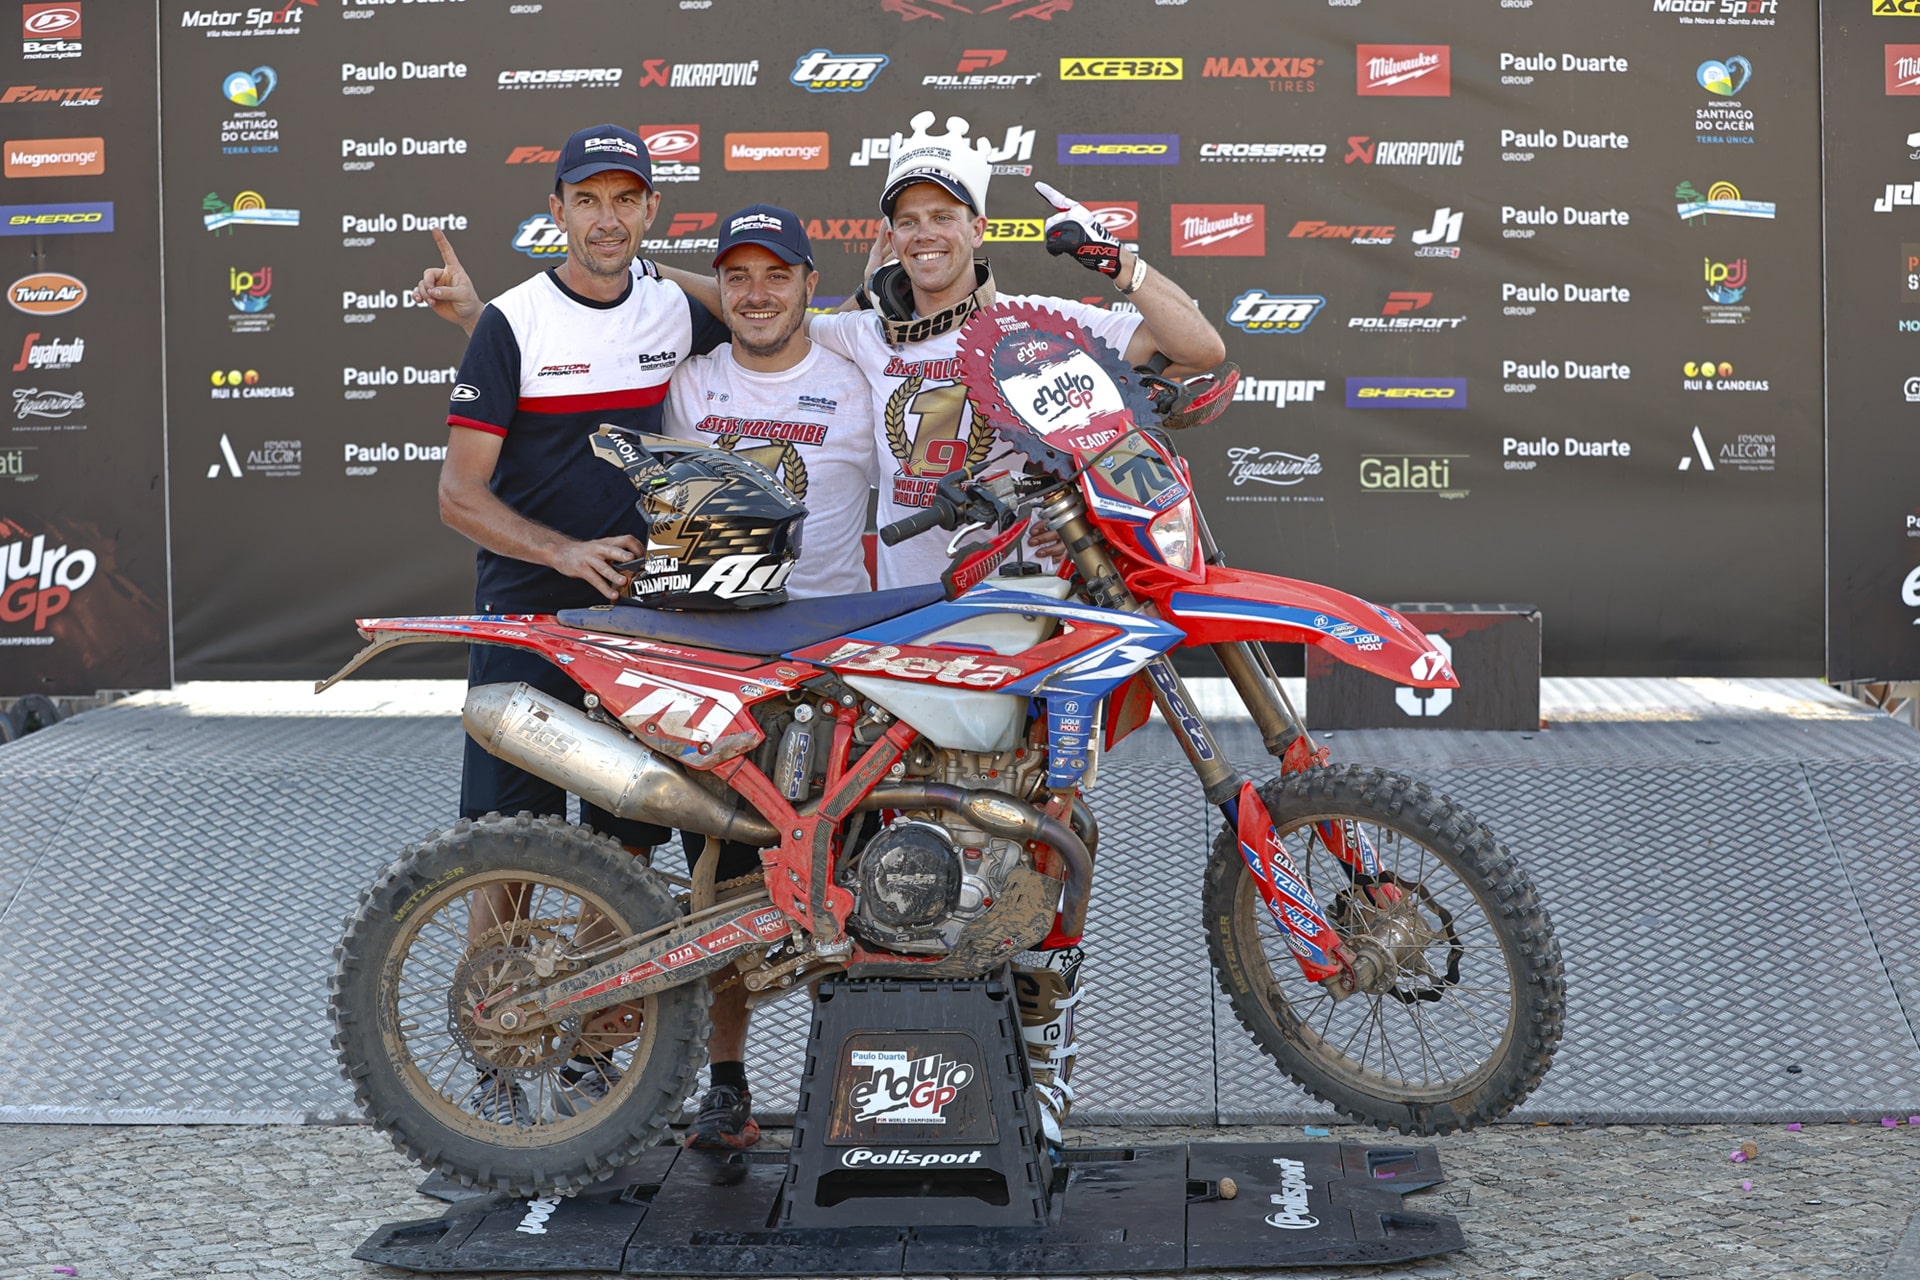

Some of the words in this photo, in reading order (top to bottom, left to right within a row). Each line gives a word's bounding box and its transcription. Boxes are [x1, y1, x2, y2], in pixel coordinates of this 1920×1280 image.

[510, 4, 542, 14] GROUP
[680, 0, 712, 9] GROUP
[1501, 0, 1533, 8] GROUP
[1653, 0, 1715, 13] Motor
[1720, 0, 1777, 17] Sport
[181, 9, 242, 27] Motor
[245, 7, 304, 27] Sport
[343, 10, 375, 20] GROUP
[1679, 17, 1694, 25] Vila
[1695, 17, 1715, 25] Nova
[1716, 17, 1726, 25] de
[1751, 17, 1775, 26] André
[206, 30, 223, 38] Vila
[23, 40, 82, 53] Beta
[23, 51, 82, 60] motorcycles
[1500, 53, 1556, 72] Paulo
[1562, 54, 1628, 72] Duarte
[342, 62, 397, 81] Paulo
[402, 61, 467, 79] Duarte
[1202, 57, 1316, 78] MAXXIS
[1366, 53, 1439, 81] Milwaukee
[498, 68, 622, 84] CROSSPRO
[922, 73, 1037, 86] POLISPORT
[1501, 76, 1534, 85] GROUP
[343, 86, 374, 95] GROUP
[810, 80, 864, 88] MOTO
[1269, 80, 1315, 93] TIRES
[0, 86, 103, 103] FANTIC
[60, 99, 100, 107] RACING
[1696, 109, 1753, 120] SANTIAGO
[222, 119, 278, 131] SANTIAGO
[1695, 121, 1712, 131] DO
[1715, 119, 1755, 132] CACÉM
[221, 131, 239, 142] DO
[241, 129, 279, 142] CACÉM
[1501, 129, 1557, 148] Paulo
[1563, 130, 1629, 149] Duarte
[1696, 136, 1723, 144] TERRA
[1726, 134, 1755, 144] ÚNICA
[222, 146, 248, 155] TERRA
[342, 138, 397, 157] Paulo
[402, 137, 467, 155] Duarte
[585, 138, 637, 154] Beta
[732, 145, 821, 159] Magnorange
[1070, 145, 1167, 154] SHERCO
[1200, 144, 1326, 157] CROSSPRO
[11, 151, 97, 167] Magnorange
[1502, 152, 1534, 162] GROUP
[343, 162, 374, 171] GROUP
[9, 212, 102, 225] SHERCO
[342, 215, 397, 233] Paulo
[402, 213, 467, 231] Duarte
[731, 214, 782, 228] Beta
[1502, 206, 1557, 225] Paulo
[1563, 207, 1629, 226] Duarte
[1180, 213, 1254, 240] Milwaukee
[1288, 221, 1396, 238] FANTIC
[1503, 229, 1535, 239] GROUP
[343, 237, 375, 247] GROUP
[15, 286, 55, 302] Twin
[55, 286, 82, 301] Air
[343, 291, 397, 309] Paulo
[1502, 283, 1559, 302] Paulo
[1564, 284, 1630, 303] Duarte
[1503, 306, 1536, 316] GROUP
[344, 314, 375, 323] GROUP
[995, 315, 1017, 326] PRIME
[1246, 321, 1300, 329] MOTO
[1348, 317, 1461, 328] POLISPORT
[1000, 321, 1030, 332] STADIUM
[12, 333, 85, 371] Segafredo
[639, 352, 676, 364] Beta
[344, 367, 398, 385] Paulo
[403, 366, 457, 384] Duart
[1503, 360, 1559, 379] Paulo
[1565, 361, 1631, 380] Duarte
[211, 388, 229, 399] RUI
[232, 388, 241, 398] &
[243, 386, 294, 399] CANDEIAS
[1504, 383, 1536, 393] GROUP
[1684, 380, 1702, 391] RUI
[1705, 380, 1714, 391] &
[1716, 380, 1769, 391] CANDEIAS
[345, 390, 376, 399] GROUP
[1033, 372, 1094, 415] enduro
[1358, 388, 1455, 398] SHERCO
[12, 388, 87, 419] Figueirinha
[799, 395, 837, 406] Beta
[741, 421, 827, 444] HOLCOMBE
[345, 443, 400, 461] Paulo
[404, 443, 448, 460] Duar
[1503, 437, 1559, 456] Paulo
[1565, 438, 1631, 457] Duarte
[1719, 443, 1775, 457] ALEGRIM
[247, 449, 301, 465] ALEGRIM
[346, 466, 378, 476] GROUP
[1227, 447, 1322, 486] Figueirinha
[1504, 461, 1536, 470] GROUP
[1360, 458, 1450, 488] Galati
[895, 479, 923, 493] WORLD
[894, 493, 920, 506] WORLD
[1156, 487, 1182, 506] Beta
[645, 557, 679, 575] WORLD
[634, 574, 692, 595] CHAMPION
[1354, 635, 1380, 644] LIQUI
[1358, 642, 1383, 651] MOLY
[843, 645, 1022, 687] Beta
[1147, 662, 1214, 761] Beta
[1060, 724, 1080, 732] MOLY
[788, 732, 810, 798] Beta
[886, 873, 936, 882] Beta
[1252, 857, 1319, 912] MTZELER
[394, 866, 465, 922] METZELER
[754, 910, 782, 926] LIQUI
[759, 918, 786, 935] MOLY
[708, 932, 744, 949] EXCEL
[1220, 915, 1248, 993] METZELER
[853, 1052, 876, 1060] Paulo
[878, 1053, 905, 1061] Duarte
[850, 1054, 974, 1108] enduro
[842, 1147, 982, 1167] Polisport
[1267, 1158, 1319, 1229] Polisport
